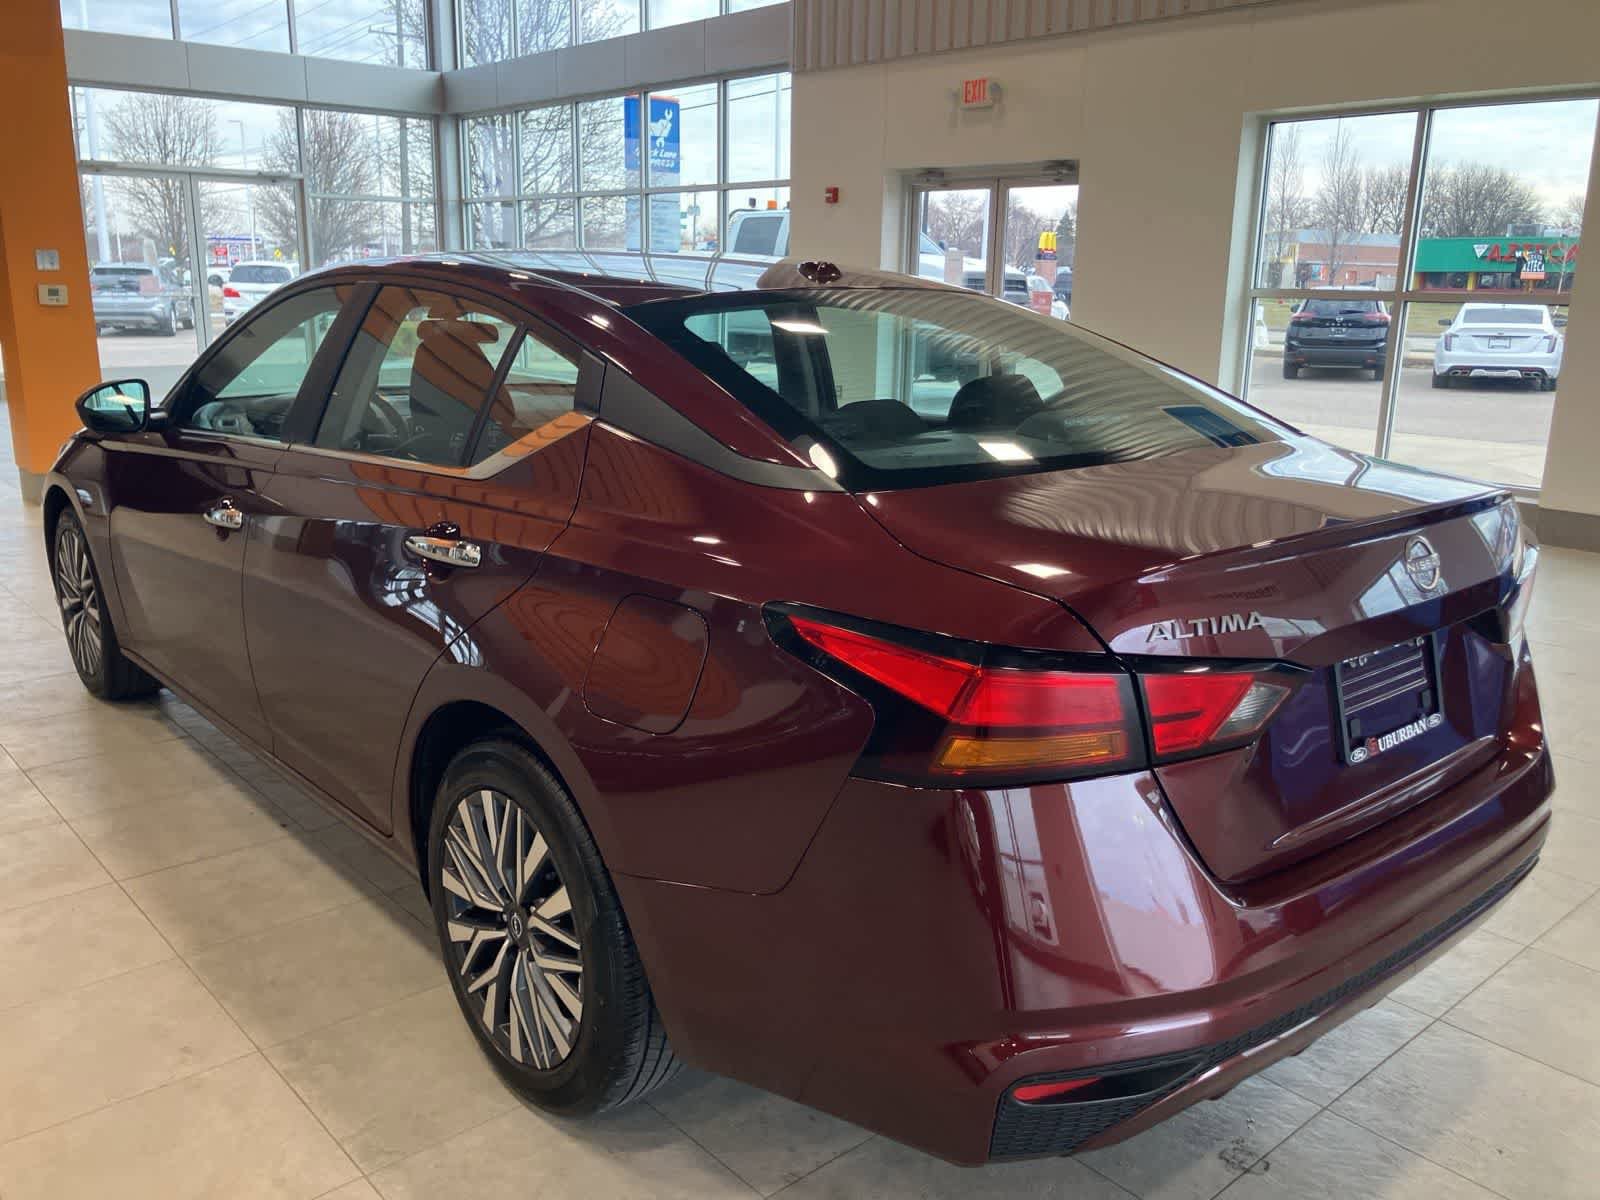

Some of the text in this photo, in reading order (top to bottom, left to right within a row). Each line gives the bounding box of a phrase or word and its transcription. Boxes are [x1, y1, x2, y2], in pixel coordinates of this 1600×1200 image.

[964, 79, 988, 104] EXIT
[1146, 611, 1265, 642] ALTIMA
[1366, 719, 1428, 757] SUBURBAN
